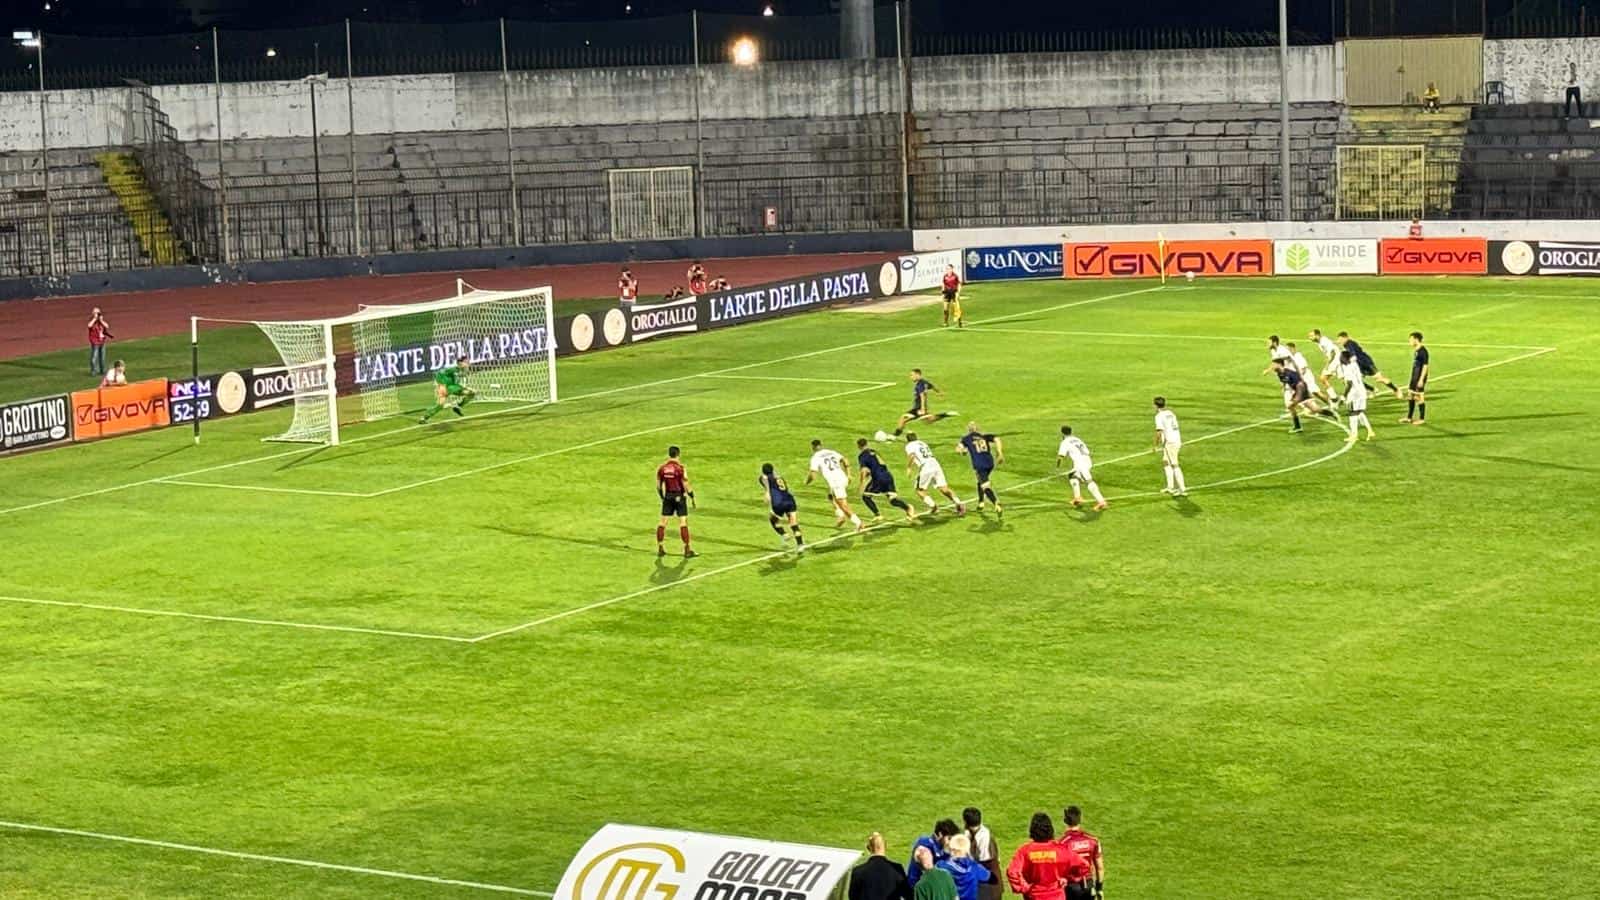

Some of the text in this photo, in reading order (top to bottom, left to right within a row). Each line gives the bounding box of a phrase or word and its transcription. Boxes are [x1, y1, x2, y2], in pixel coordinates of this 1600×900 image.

[1108, 251, 1263, 275] GIVOVA
[1316, 244, 1367, 258] VIRIDE
[1404, 251, 1482, 264] GIVOVA
[710, 271, 870, 322] L'ARTE DELLA PASTA
[631, 306, 697, 332] OROGIALLO
[353, 348, 425, 384] L'ARTE
[3, 398, 66, 435] GROTTINO
[94, 398, 165, 424] GIVOVA
[707, 850, 831, 892] GOLDEN
